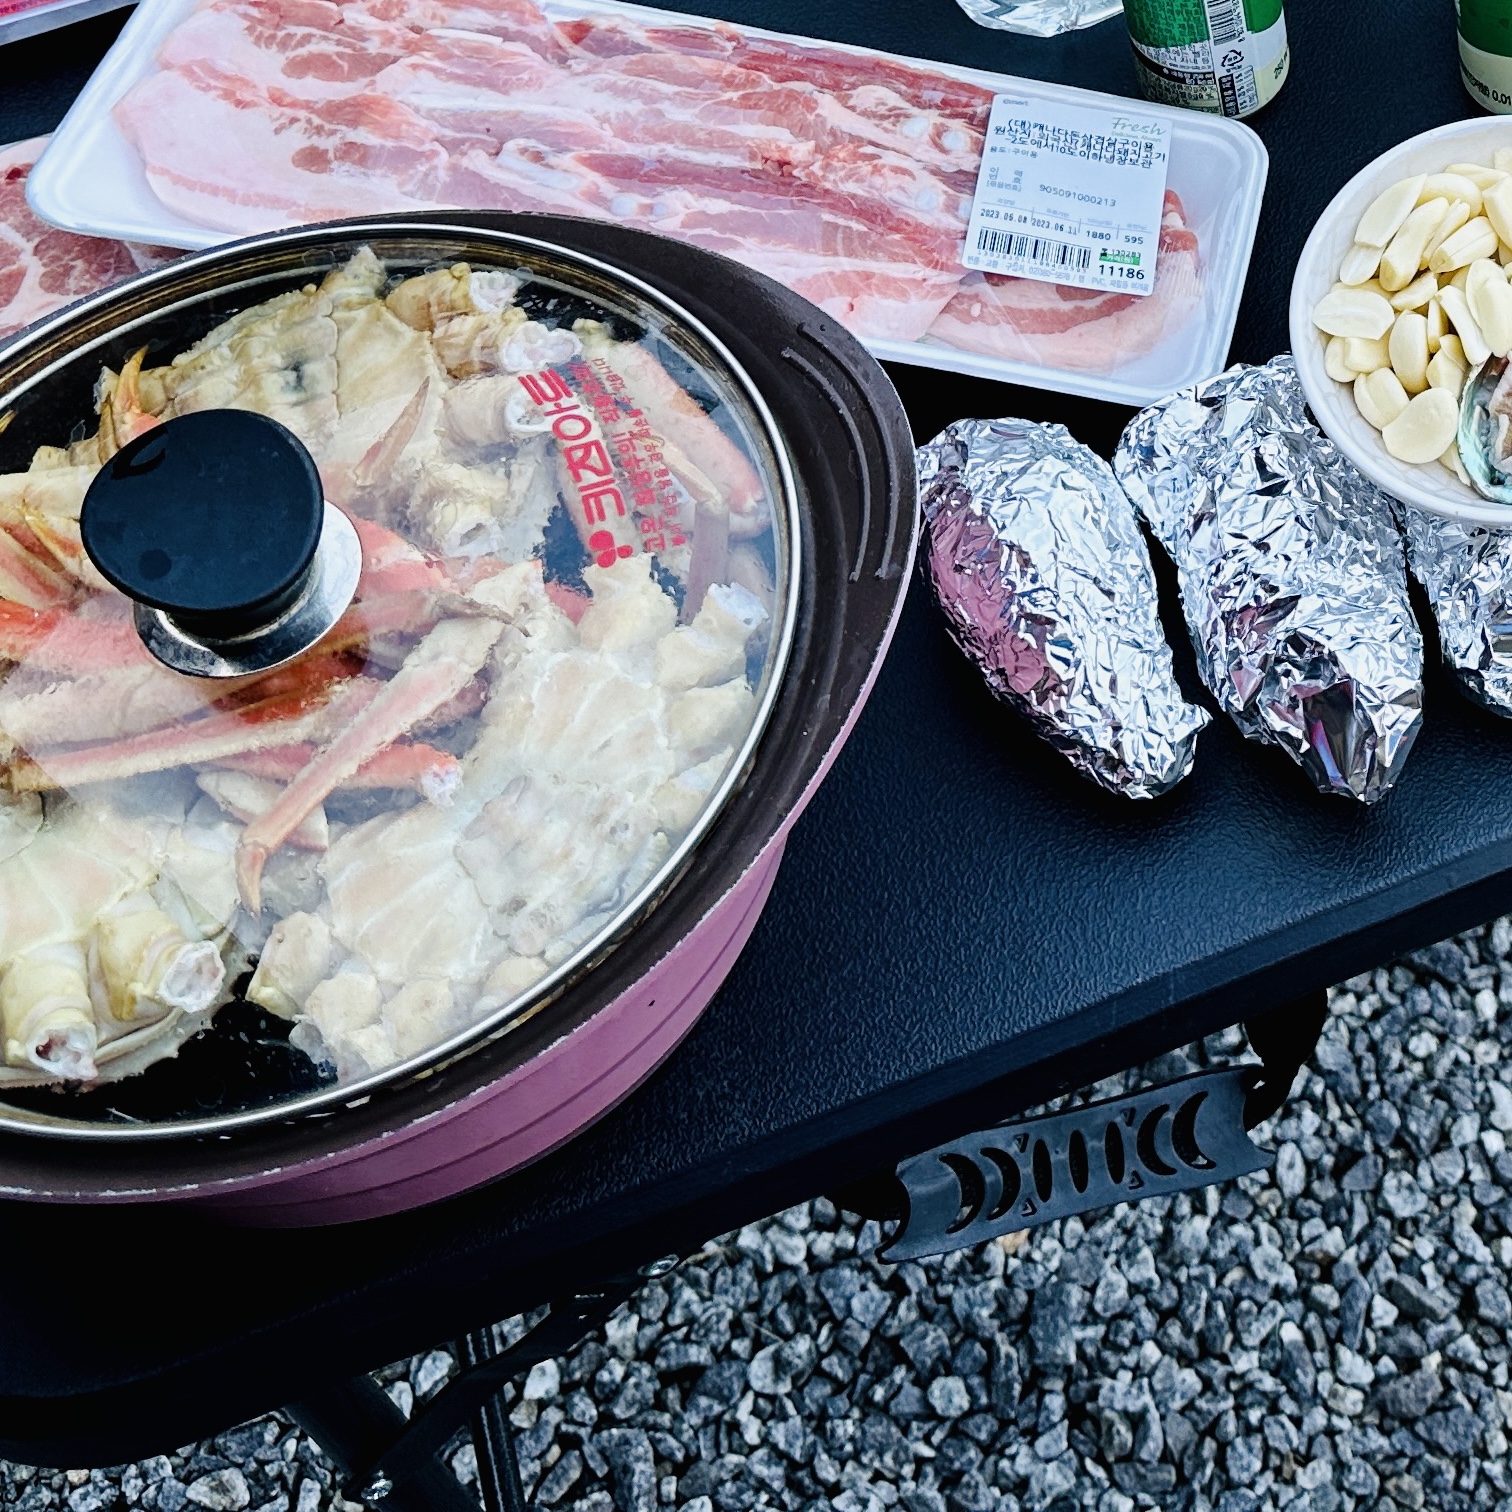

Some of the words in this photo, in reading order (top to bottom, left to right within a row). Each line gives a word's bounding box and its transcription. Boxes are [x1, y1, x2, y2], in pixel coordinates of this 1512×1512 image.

[1491, 89, 1512, 107] 0.01
[1111, 116, 1166, 137] Fresh
[1038, 182, 1117, 208] 905091000213
[1085, 229, 1112, 242] 1880
[1123, 234, 1145, 246] 595
[1098, 263, 1146, 281] 11186
[517, 367, 629, 527] 키친아트
